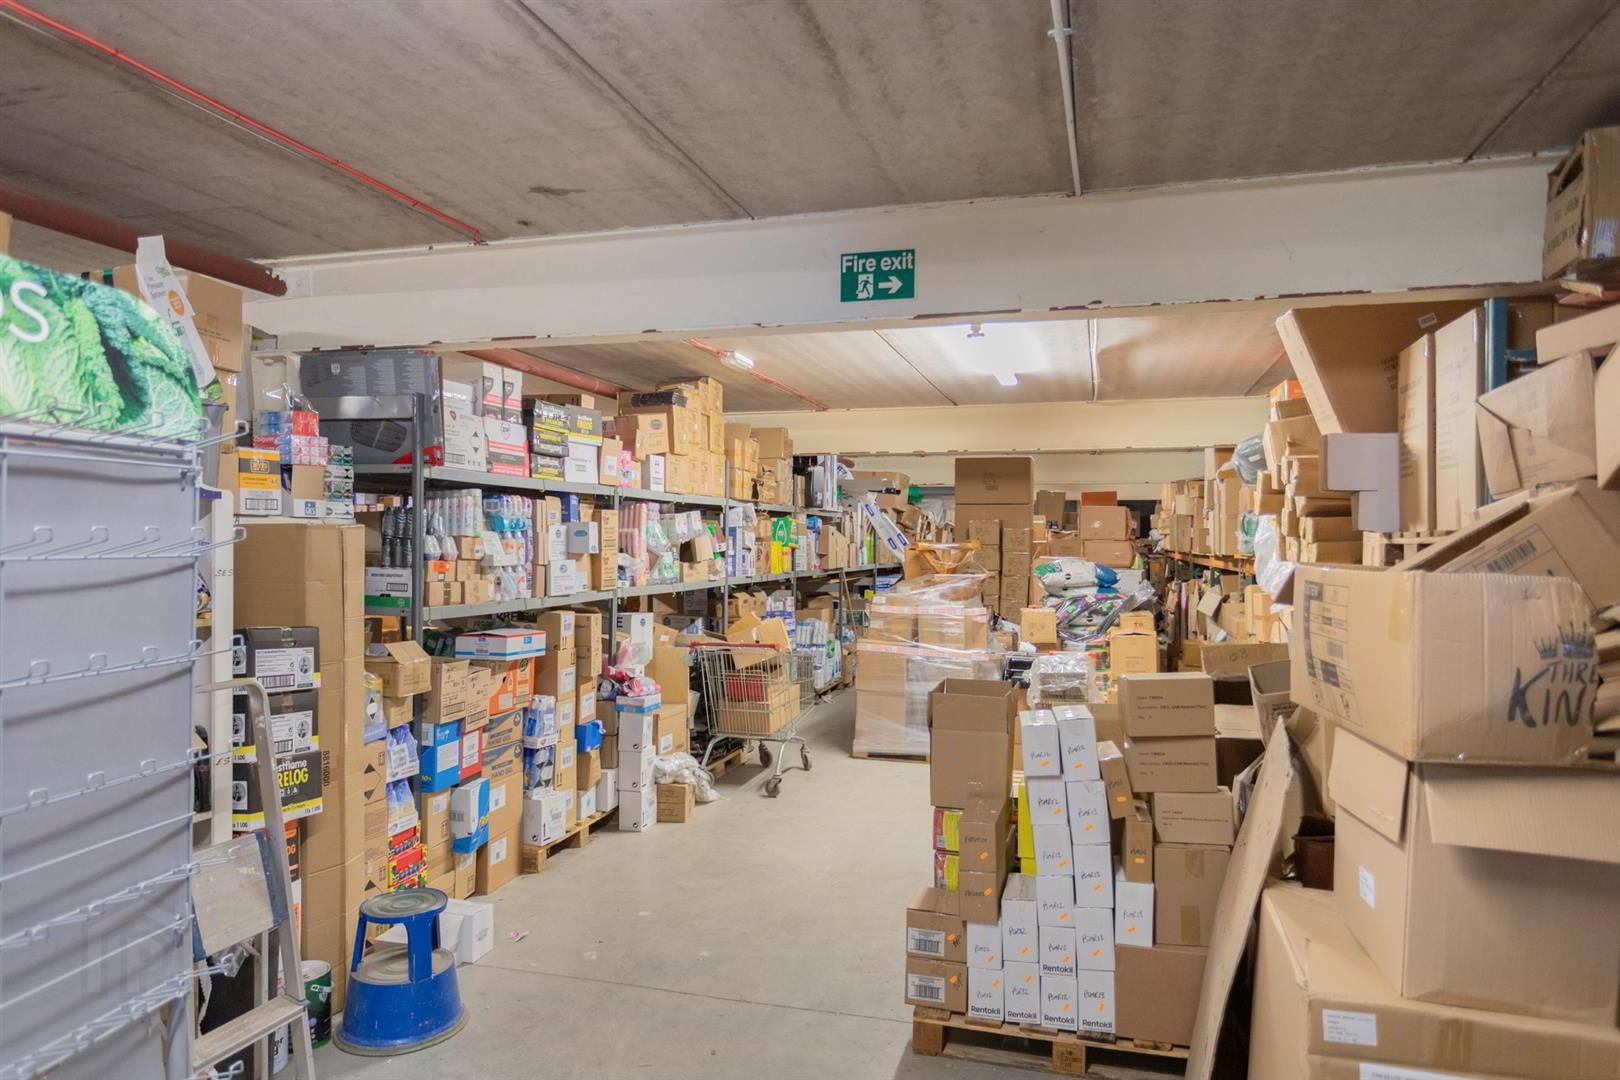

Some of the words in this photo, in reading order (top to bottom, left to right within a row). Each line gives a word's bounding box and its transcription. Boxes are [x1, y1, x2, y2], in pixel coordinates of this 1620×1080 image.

[842, 255, 876, 273] Fire
[880, 252, 914, 271] exit
[0, 281, 48, 342] S
[1508, 667, 1595, 728] KIN
[277, 768, 308, 788] RELOG
[1042, 963, 1073, 974] Rentokil
[970, 1004, 1001, 1016] Rentokil
[1007, 1010, 1037, 1020] Rentokil
[1043, 1014, 1075, 1025] Rentokil
[1082, 1018, 1113, 1029] Rentokil
